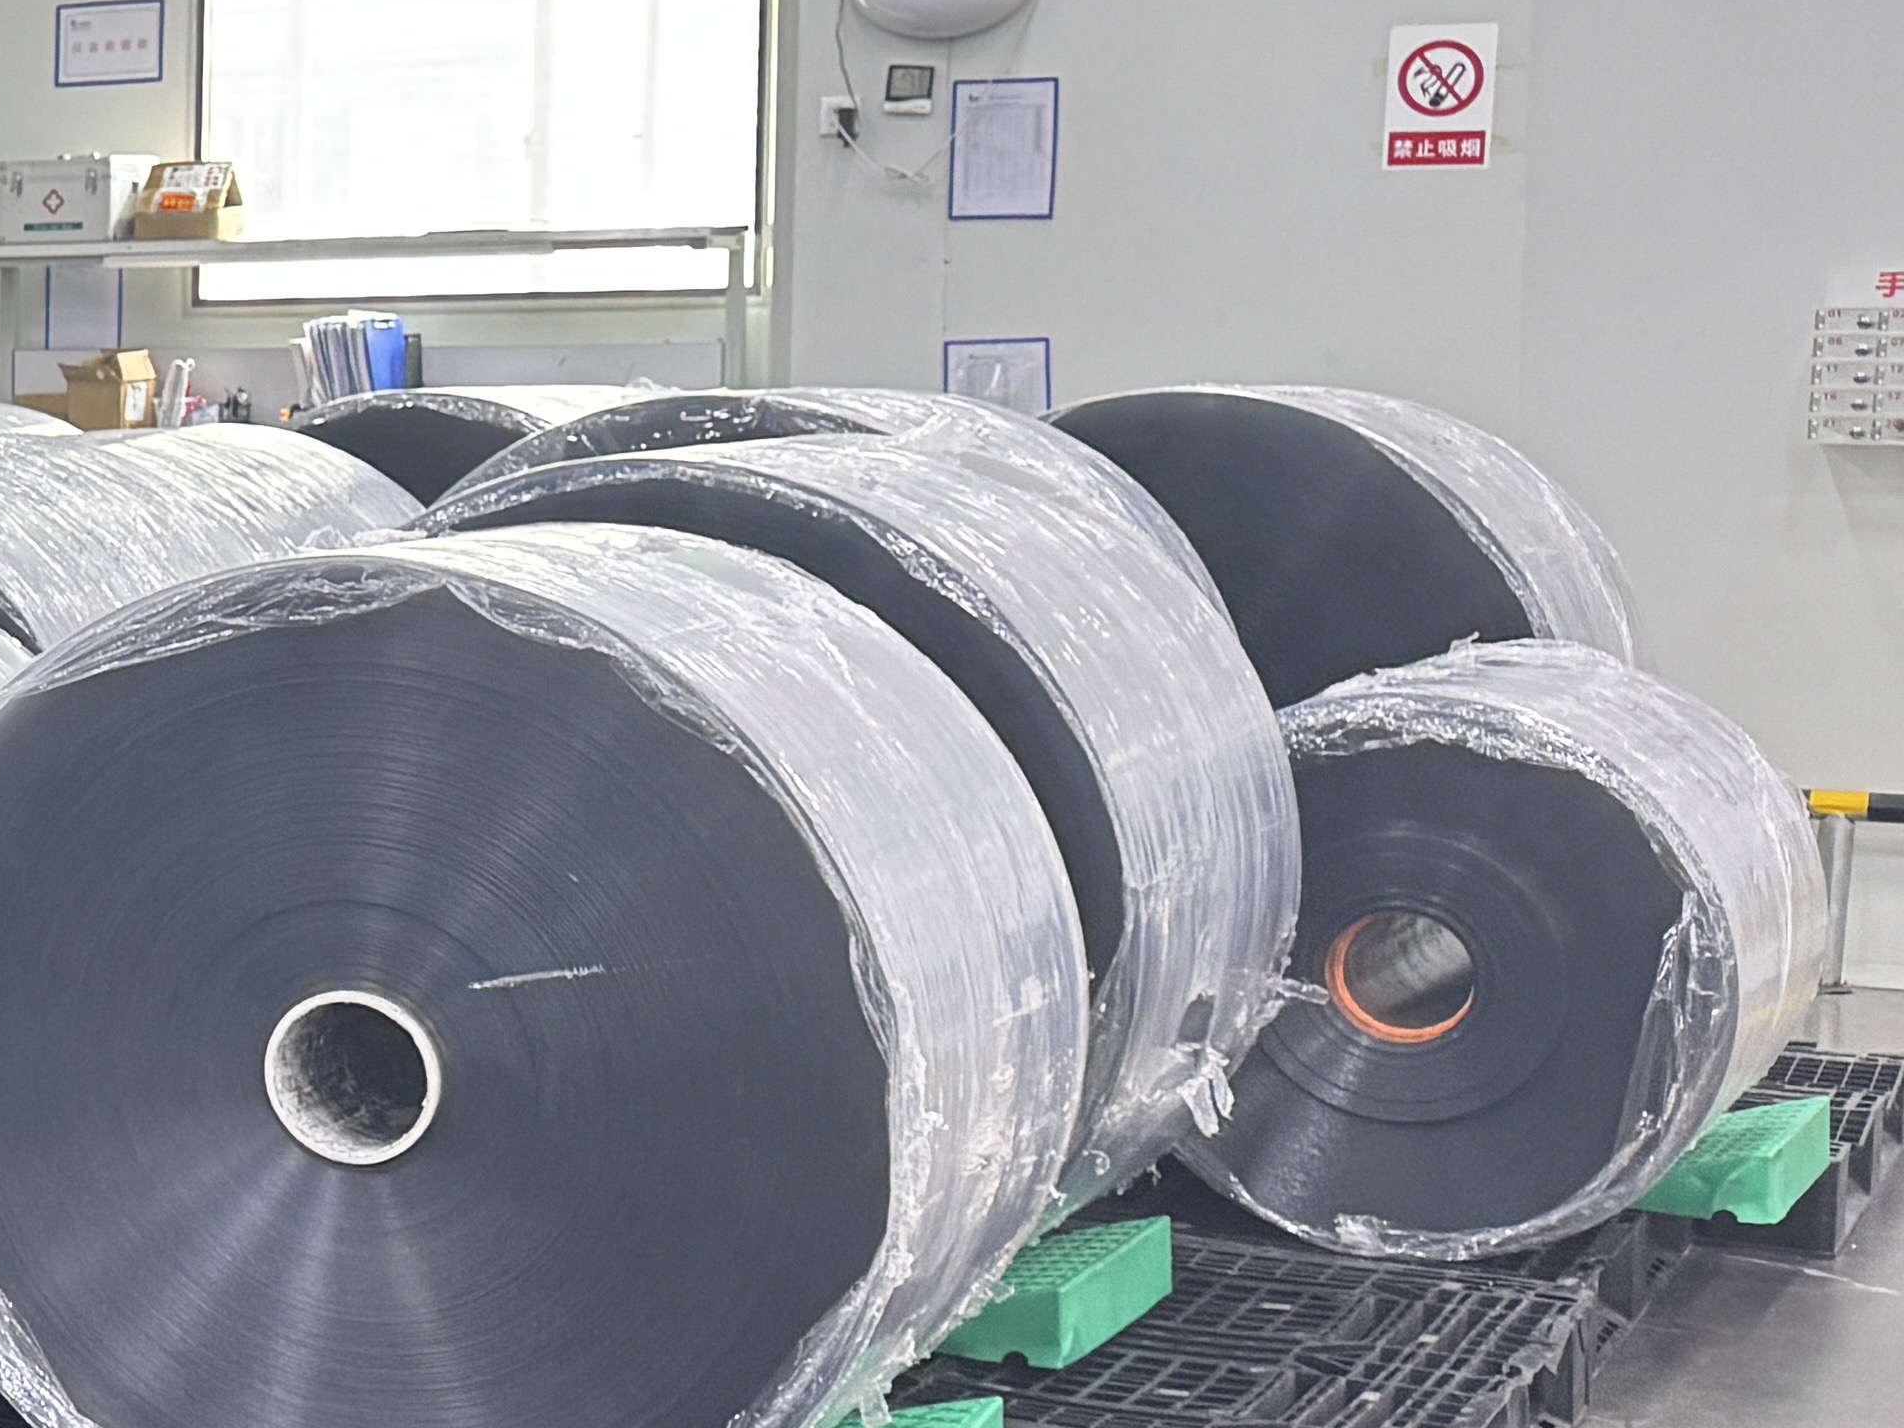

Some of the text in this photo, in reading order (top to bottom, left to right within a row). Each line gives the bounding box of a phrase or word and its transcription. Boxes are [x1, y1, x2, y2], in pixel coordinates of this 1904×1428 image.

[1393, 138, 1480, 159] 禁止吸烟
[1875, 271, 1904, 298] 手
[1827, 309, 1841, 318] 01
